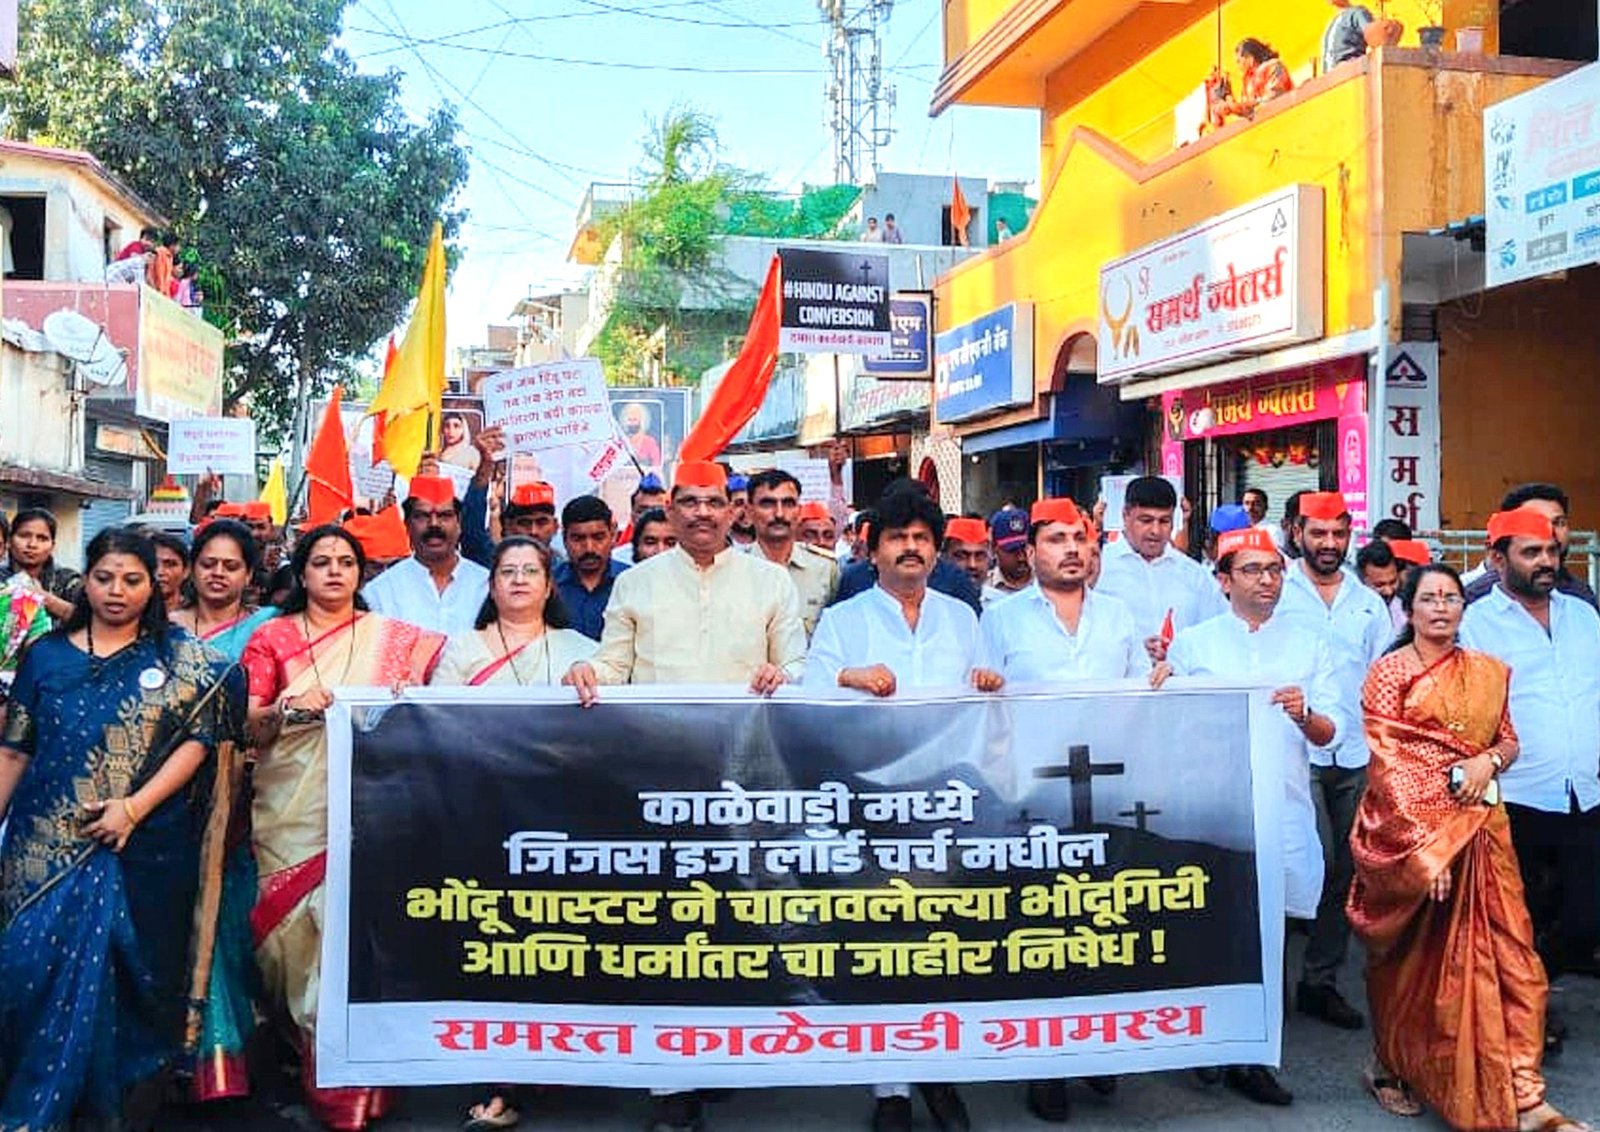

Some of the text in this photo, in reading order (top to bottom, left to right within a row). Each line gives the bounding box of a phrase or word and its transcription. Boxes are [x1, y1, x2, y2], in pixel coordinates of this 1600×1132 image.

[784, 281, 884, 303] #HINDU AGAINST
[1146, 245, 1288, 334] समर्थ ज्वेलर्स
[799, 306, 875, 327] CONVERSION
[638, 779, 979, 825] काळेवाडी मध्ये
[502, 828, 1109, 878] जिजस इज लॉर्ड चर्च मधील
[406, 865, 1210, 934] भोंदू पास्टर ने चालवलेल्या भोंदूगिरी
[462, 924, 1167, 979] आणि धर्मांतर चा जाहीर निषेध !
[432, 1005, 1207, 1056] समस्त काळेवाडी ग्रामस्थ
